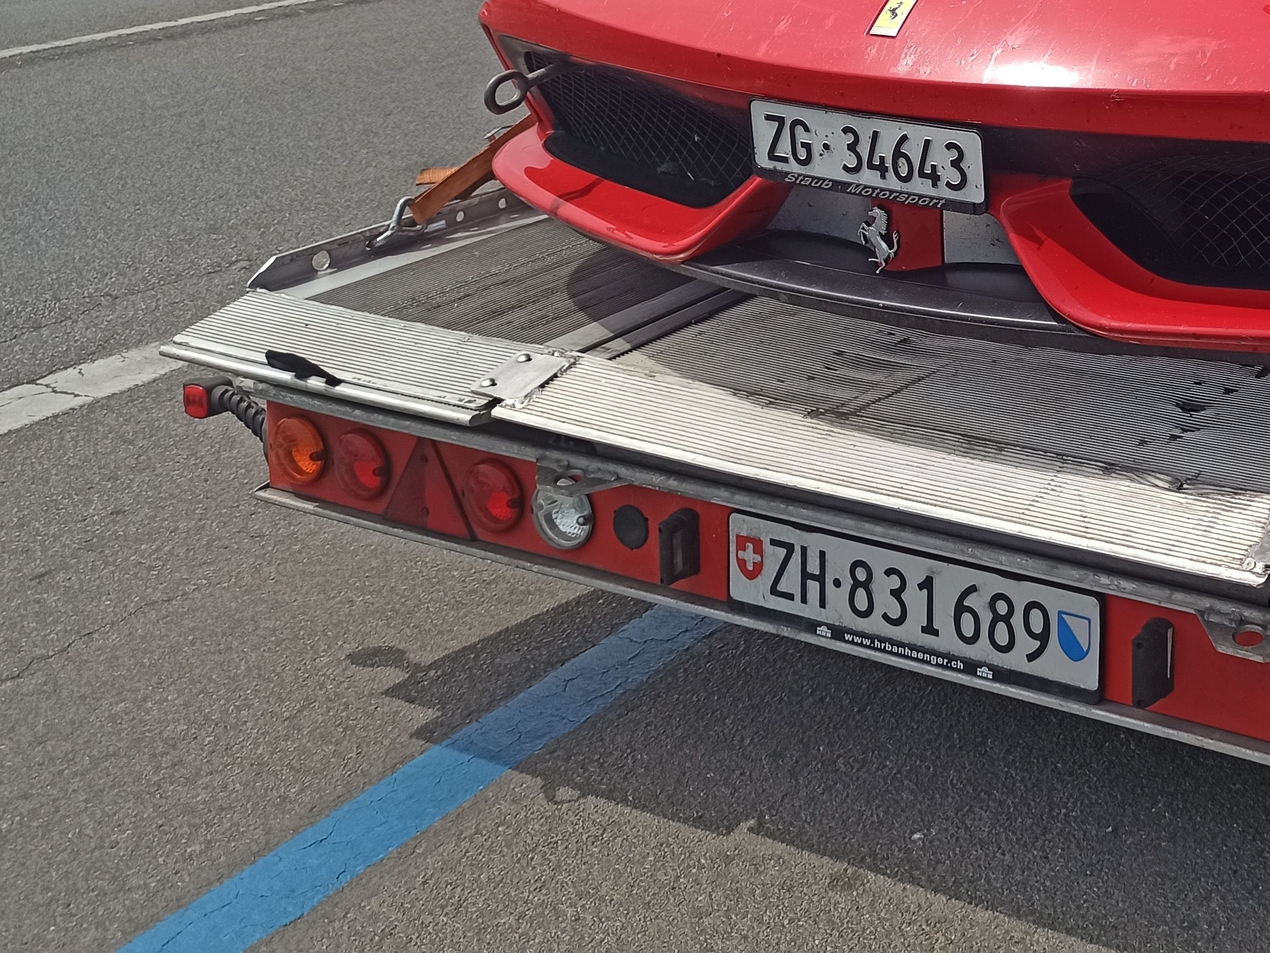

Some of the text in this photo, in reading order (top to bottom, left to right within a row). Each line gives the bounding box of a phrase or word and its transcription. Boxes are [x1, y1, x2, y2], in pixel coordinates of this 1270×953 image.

[785, 173, 946, 208] Staub Motorsport
[844, 632, 964, 670] www.hrbanhaenger.ch
